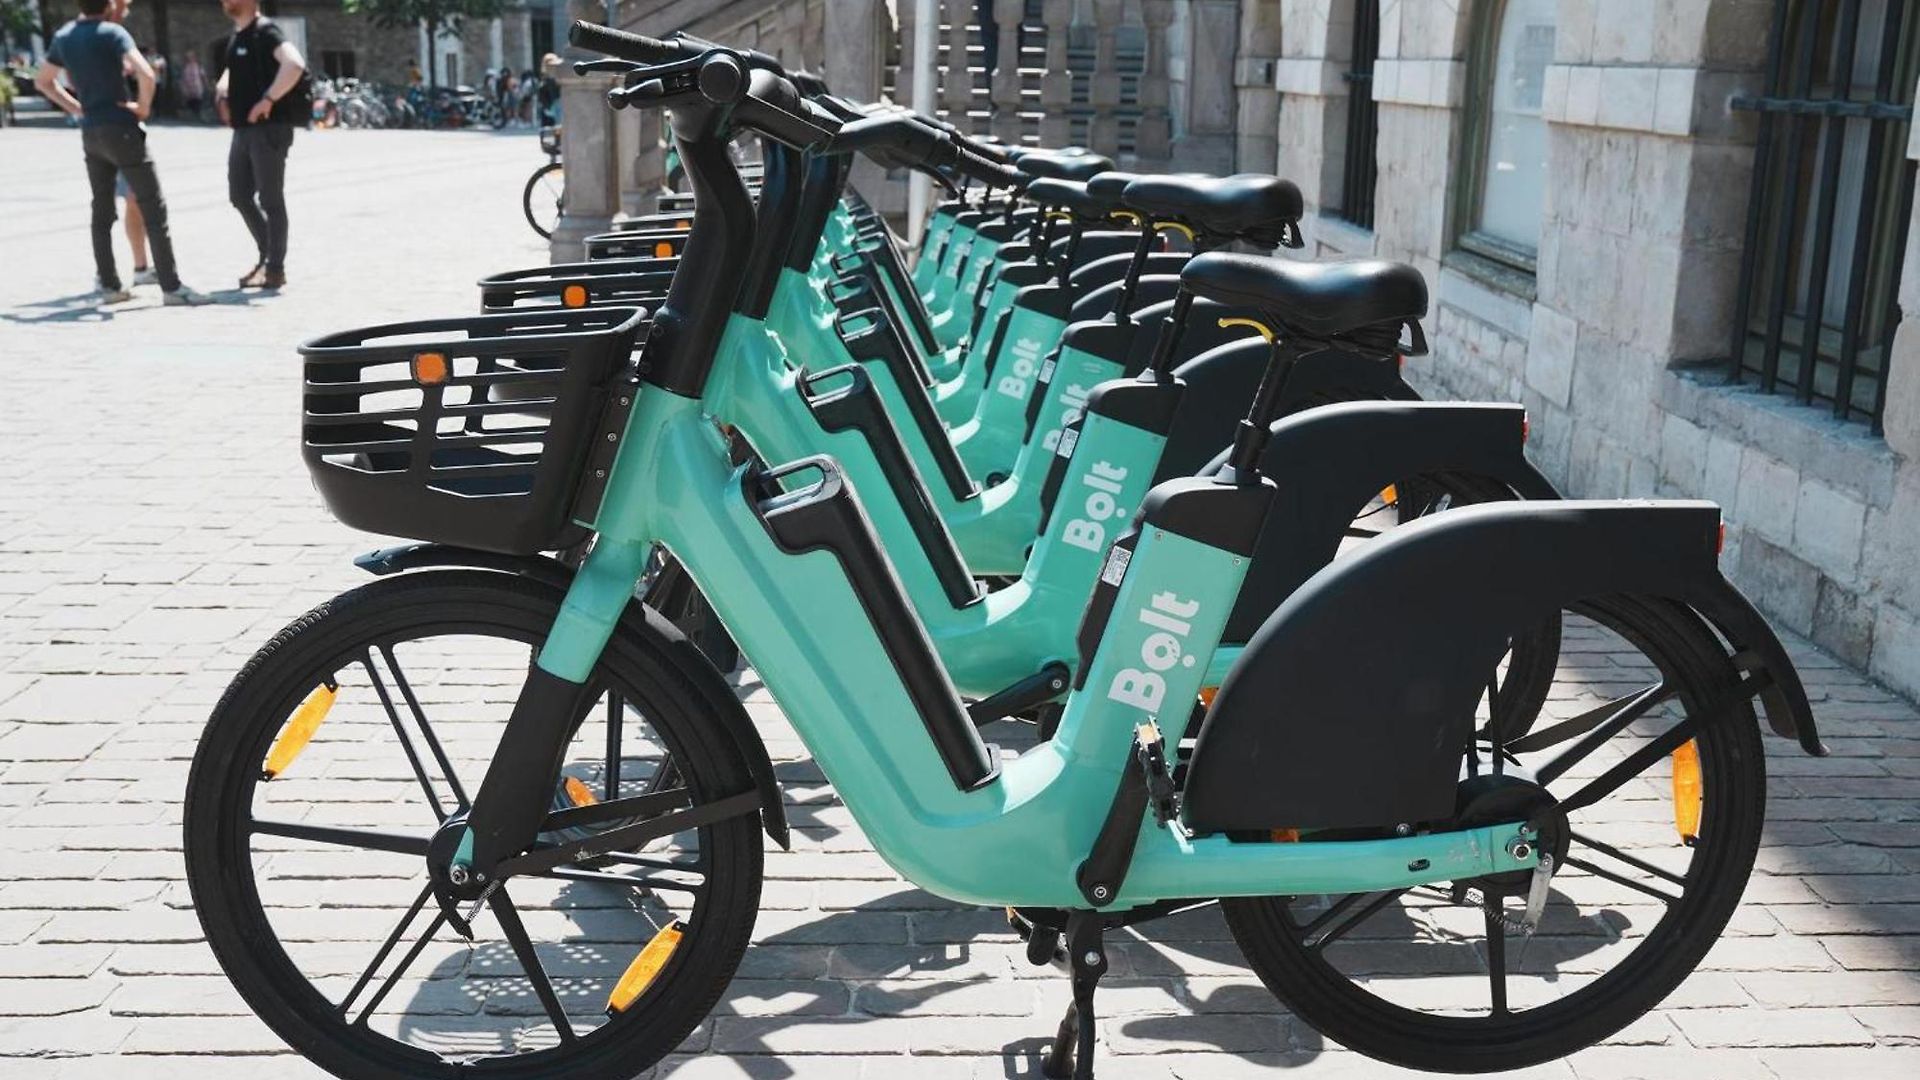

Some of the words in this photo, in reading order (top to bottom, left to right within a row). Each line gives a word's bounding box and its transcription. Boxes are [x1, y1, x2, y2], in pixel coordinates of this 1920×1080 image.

[997, 338, 1041, 400] Bolt
[1061, 461, 1127, 553] Bolt
[1107, 590, 1199, 713] Bolt
